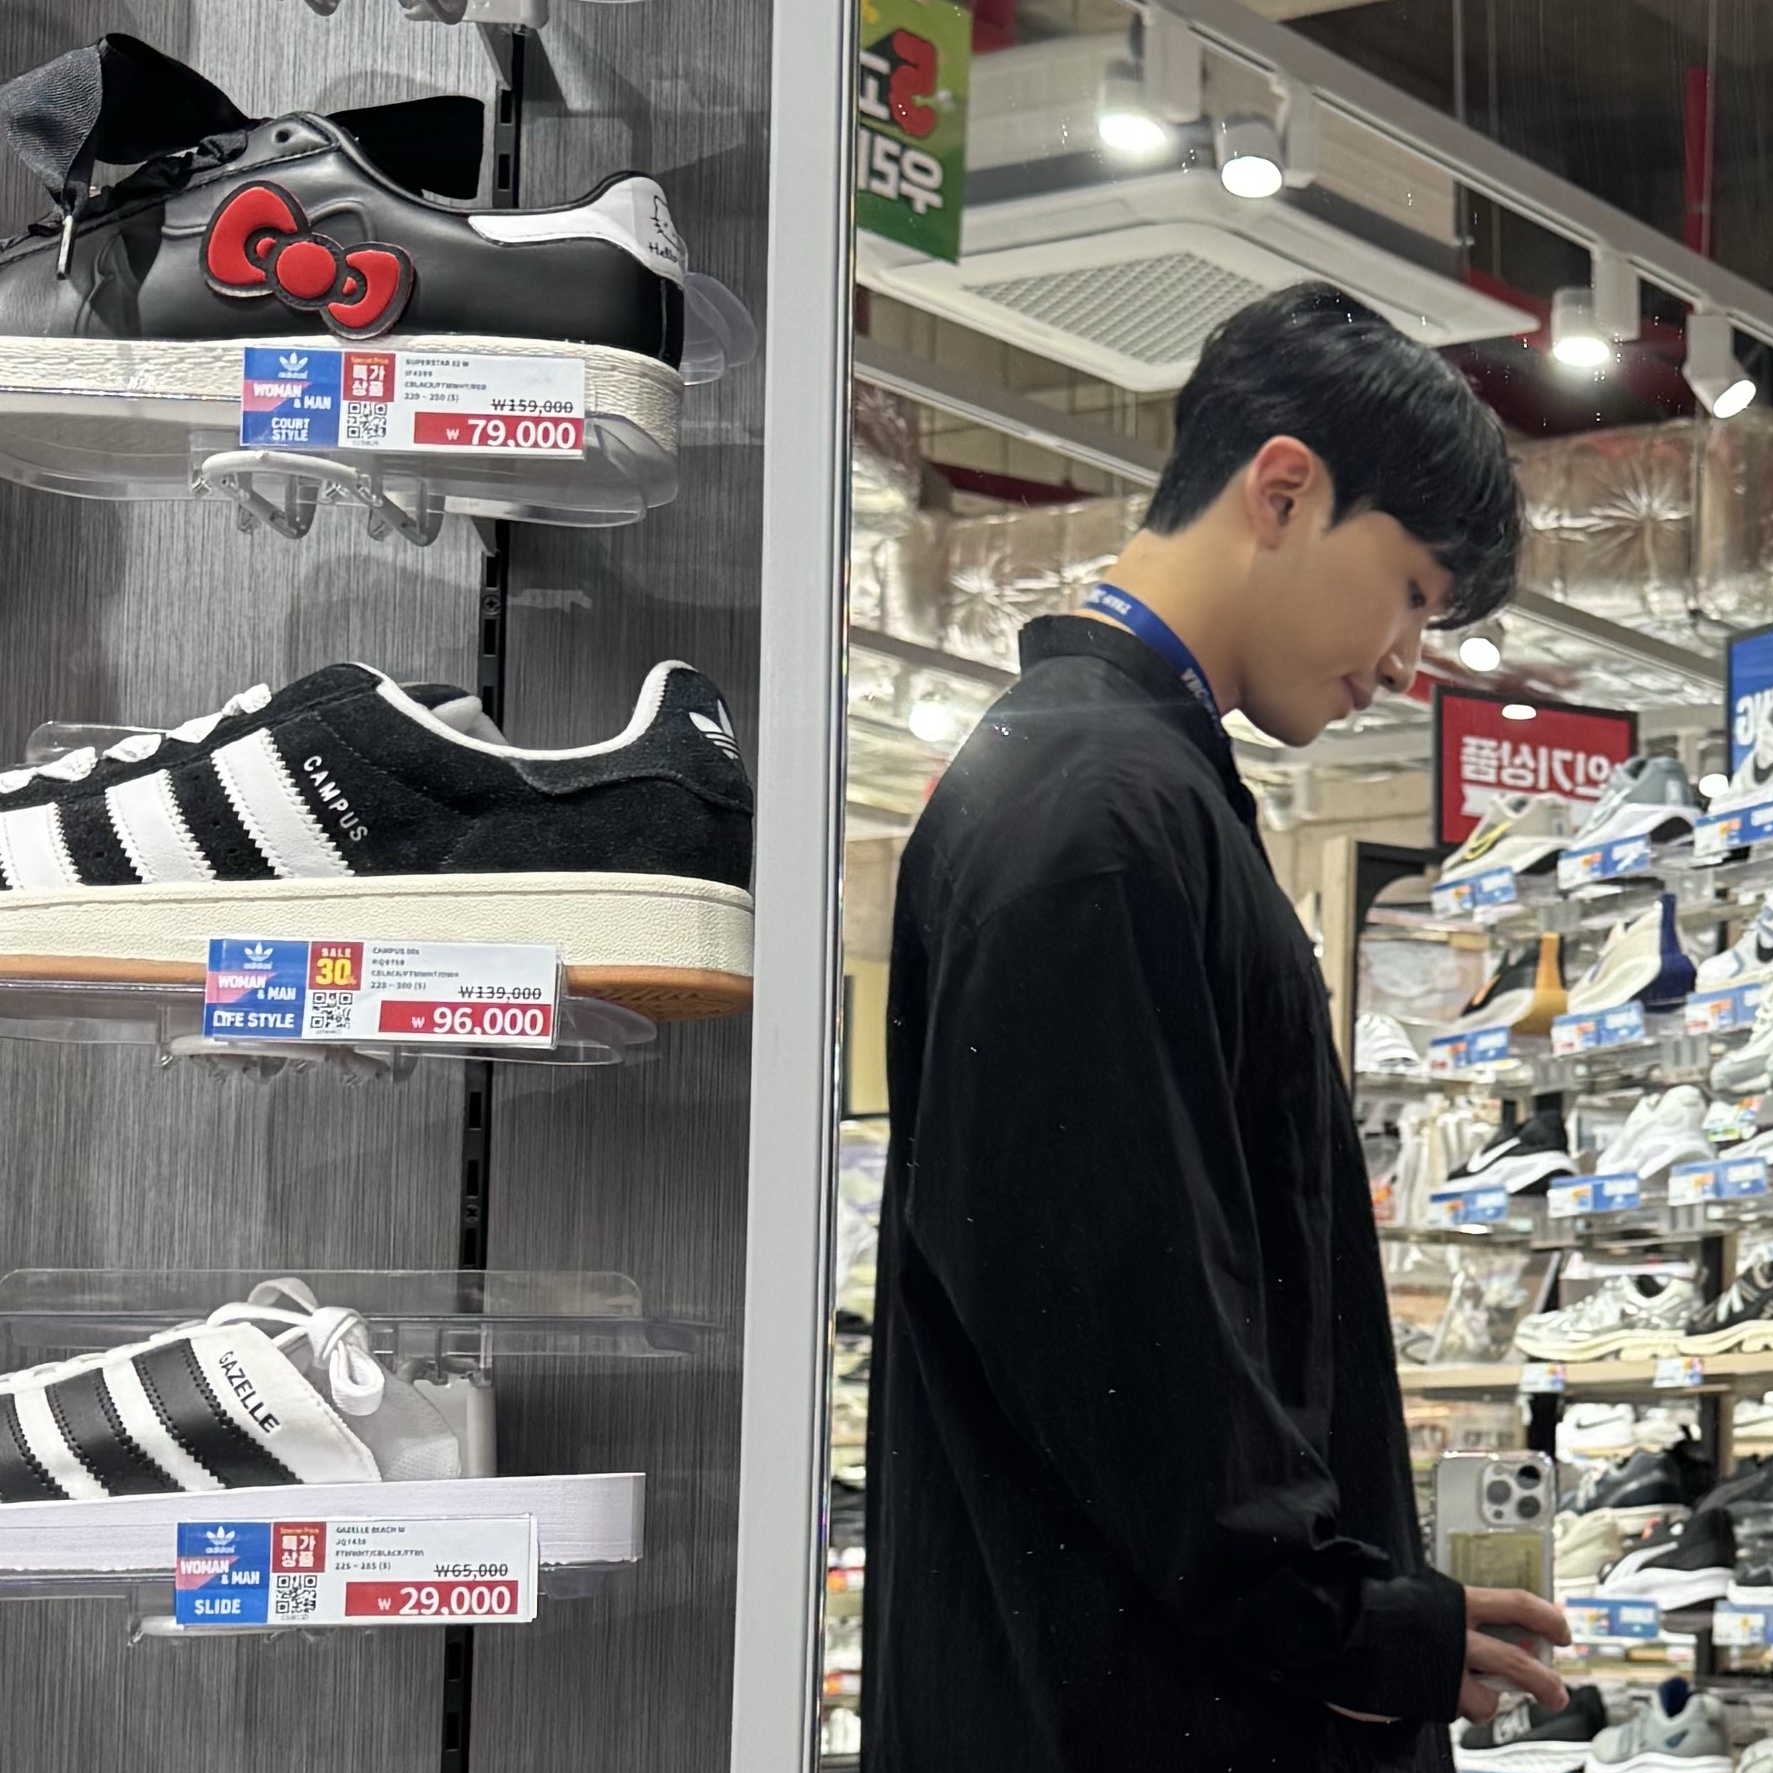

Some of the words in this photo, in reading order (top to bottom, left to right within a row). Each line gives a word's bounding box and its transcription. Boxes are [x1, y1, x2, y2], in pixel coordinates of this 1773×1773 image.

[352, 364, 386, 381] 특가
[253, 383, 303, 397] WOMAN
[352, 380, 385, 398] 상품
[304, 396, 332, 410] MAN
[271, 417, 310, 429] COURT
[272, 429, 309, 442] STYLE
[467, 418, 576, 449] 79,000
[303, 755, 368, 841] CAMPUS
[321, 947, 352, 958] SALE
[218, 974, 267, 989] WOMAN
[268, 986, 296, 1001] MAN
[213, 1010, 245, 1028] LIFE
[247, 1011, 295, 1028] STYLE
[432, 1006, 544, 1037] 96,000
[218, 1351, 280, 1433] GAZELLE
[281, 1534, 316, 1552] 특가
[180, 1559, 230, 1574] WOMAN
[281, 1551, 316, 1569] 상품
[231, 1570, 260, 1585] MAN
[194, 1598, 241, 1615] SLIDE
[399, 1585, 511, 1616] 29,000
